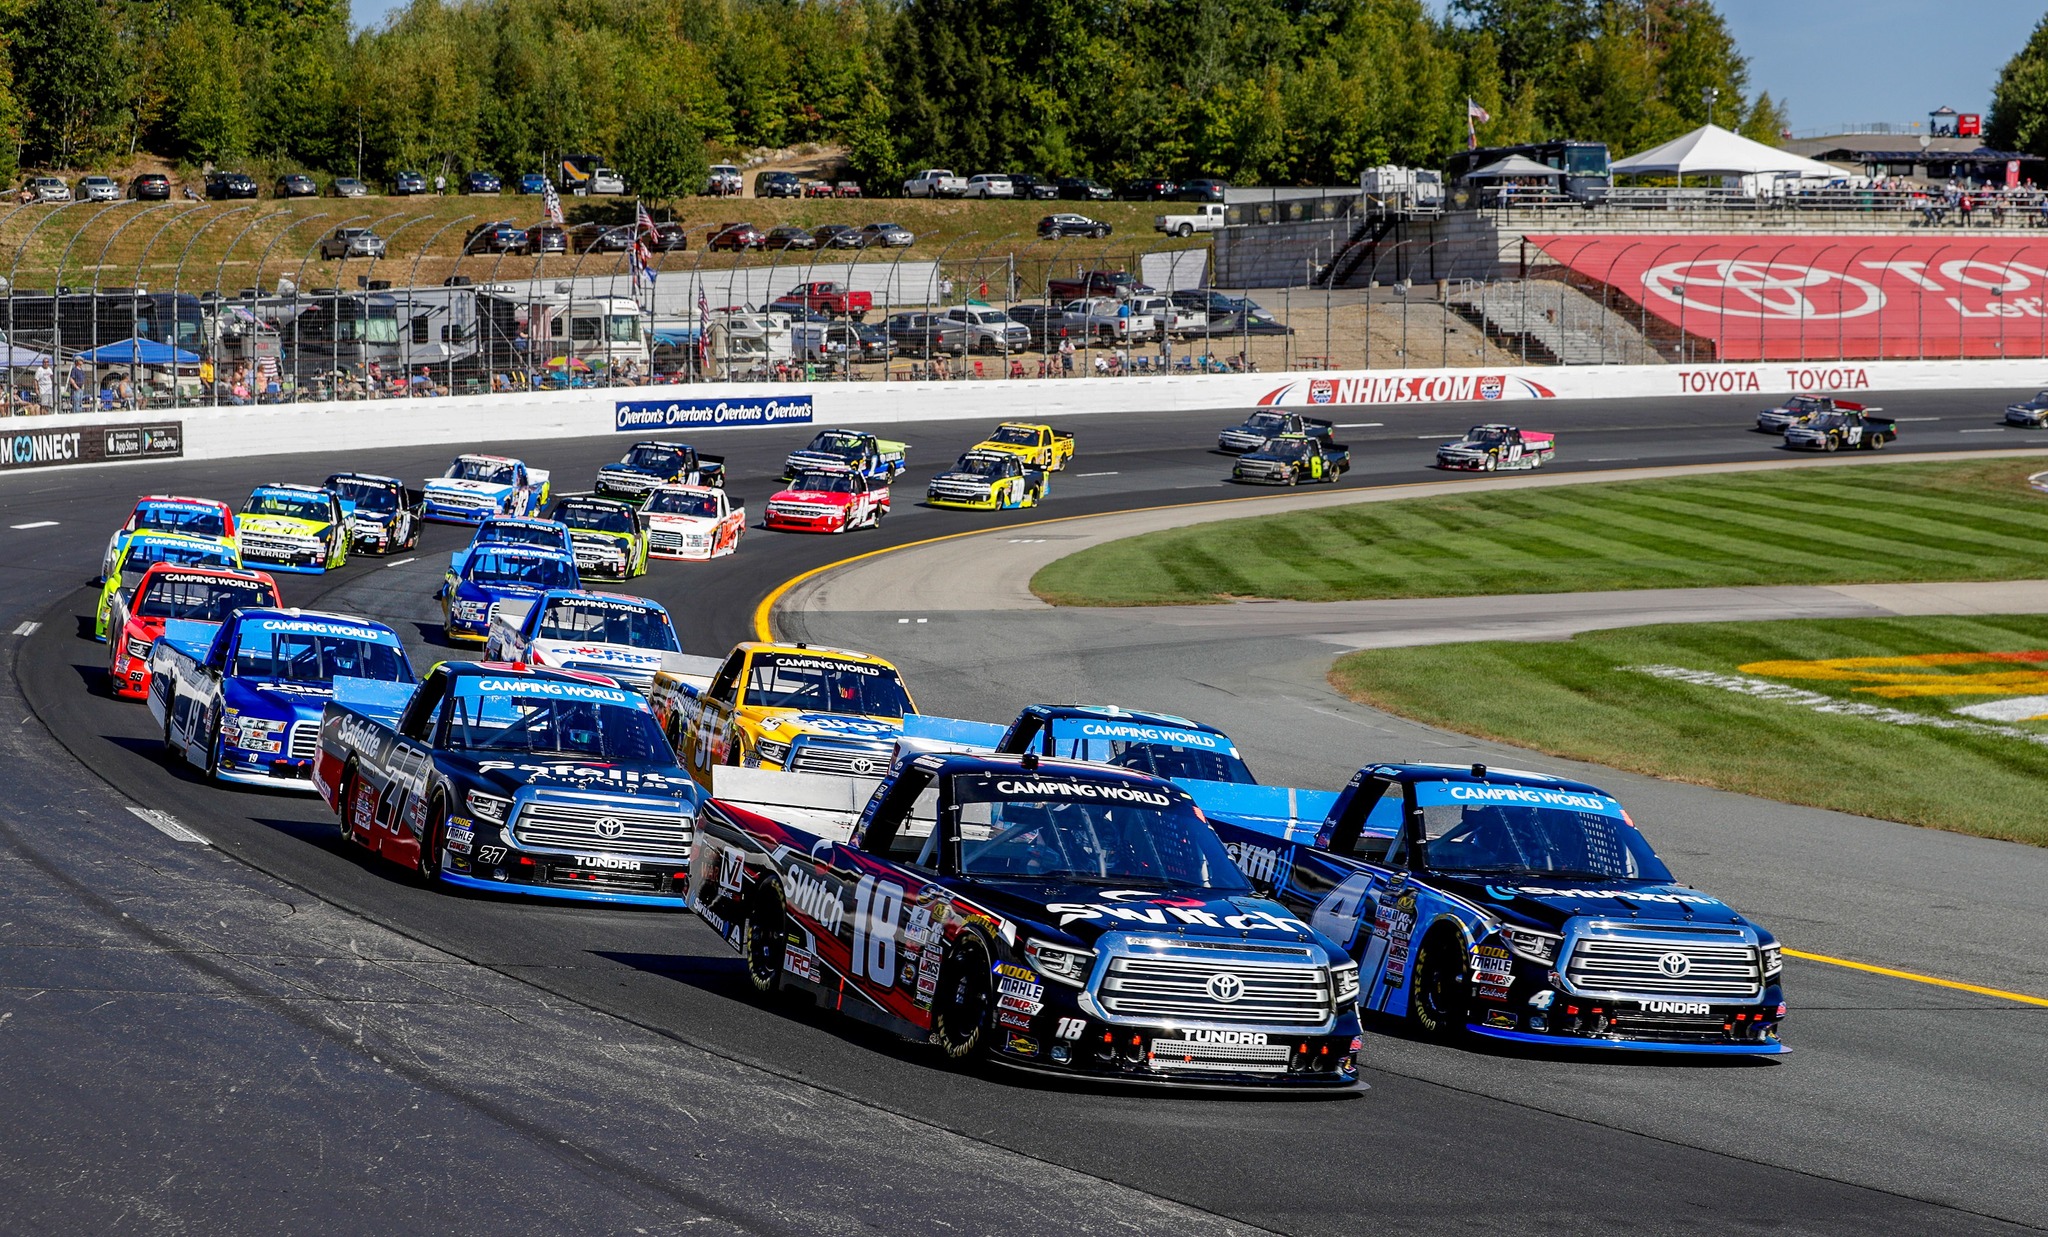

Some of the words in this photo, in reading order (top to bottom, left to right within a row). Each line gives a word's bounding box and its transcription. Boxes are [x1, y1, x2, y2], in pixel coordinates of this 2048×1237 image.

[1945, 296, 2048, 318] Let'
[1337, 375, 1477, 403] NHMS.COM
[1678, 371, 1760, 392] TOYOTA
[1787, 368, 1870, 390] TOYOTA
[617, 405, 665, 428] Overton's
[665, 403, 714, 425] Overton's
[714, 402, 762, 423] Overton's
[764, 400, 812, 421] Overton's
[115, 441, 126, 451] App
[125, 439, 138, 450] Store
[1311, 456, 1322, 478] 6
[336, 477, 363, 486] CAMPING
[363, 480, 386, 489] WORLD
[262, 489, 293, 497] CAMPING
[293, 491, 318, 500] WORLD
[688, 491, 709, 499] WORLD
[149, 502, 184, 511] CAMPING
[184, 505, 212, 514] WORLD
[595, 505, 619, 513] WORLD
[496, 521, 527, 529] CAMPING
[528, 523, 553, 533] WORLD
[144, 537, 188, 549] CAMPING
[188, 542, 224, 554] WORLD
[490, 547, 529, 557] CAMPING
[530, 550, 560, 560] WORLD
[165, 573, 217, 585] CAMPING
[218, 577, 259, 590] WORLD
[561, 599, 608, 609] CAMPING
[609, 602, 647, 614] WORLD
[263, 620, 327, 634] CAMPING
[328, 624, 379, 640] WORLD
[776, 657, 835, 670] CAMPING
[835, 662, 880, 676] WORLD
[130, 670, 144, 682] 98
[479, 680, 562, 695] CAMPING
[560, 686, 626, 702] WORLD
[338, 713, 381, 760] Safelite
[1083, 724, 1158, 740] CAMPING
[1159, 730, 1216, 748] WORLD
[374, 741, 426, 836] 27
[996, 782, 1095, 800] CAMPING
[1095, 786, 1171, 807] WORLD
[1450, 786, 1540, 802] CAMPING
[1540, 793, 1604, 810] WORLD
[449, 828, 473, 842] MAHLE
[478, 845, 508, 865] 27
[574, 855, 641, 871] TUNDRA
[1311, 869, 1375, 950] 4
[851, 872, 905, 989] 18
[1470, 944, 1510, 960] MOOG
[993, 962, 1036, 983] MOOG
[1473, 957, 1512, 973] MAHLE
[1475, 972, 1504, 982] COMP
[1001, 978, 1043, 1000] MAHLE
[1001, 994, 1031, 1009] COMP
[1528, 990, 1555, 1010] 4
[1638, 1000, 1711, 1015] TUNDRA
[1055, 1017, 1088, 1041] 18
[1181, 1028, 1269, 1046] TUNDRA
